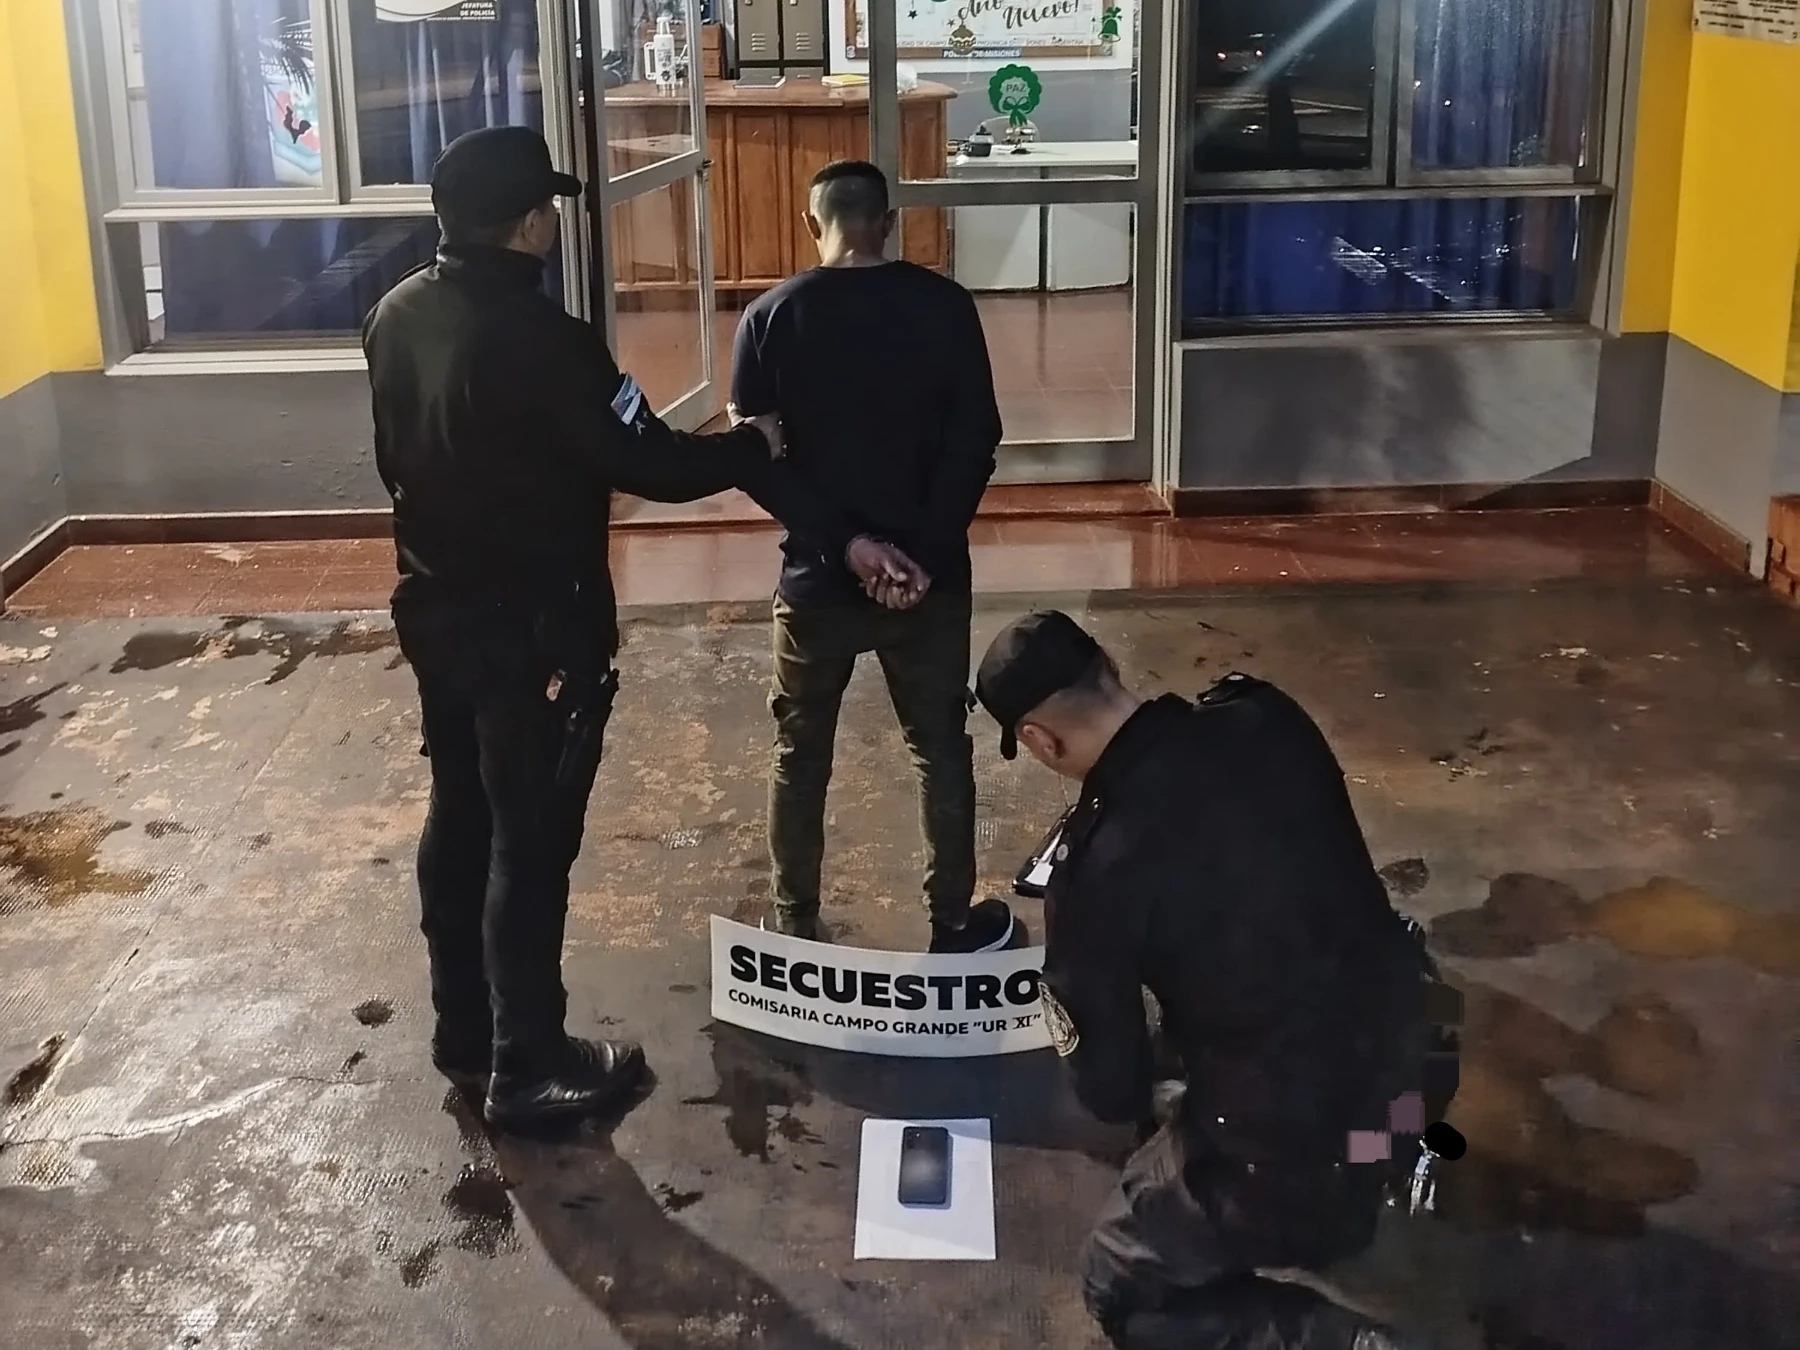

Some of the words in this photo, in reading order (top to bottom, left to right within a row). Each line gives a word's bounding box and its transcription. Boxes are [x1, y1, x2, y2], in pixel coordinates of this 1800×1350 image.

[1006, 83, 1027, 92] PAZ
[730, 944, 1043, 1011] SECUESTRO
[728, 988, 820, 1023] COMISARIA
[823, 1012, 888, 1033] CAMPO
[892, 1021, 969, 1035] GRANDE
